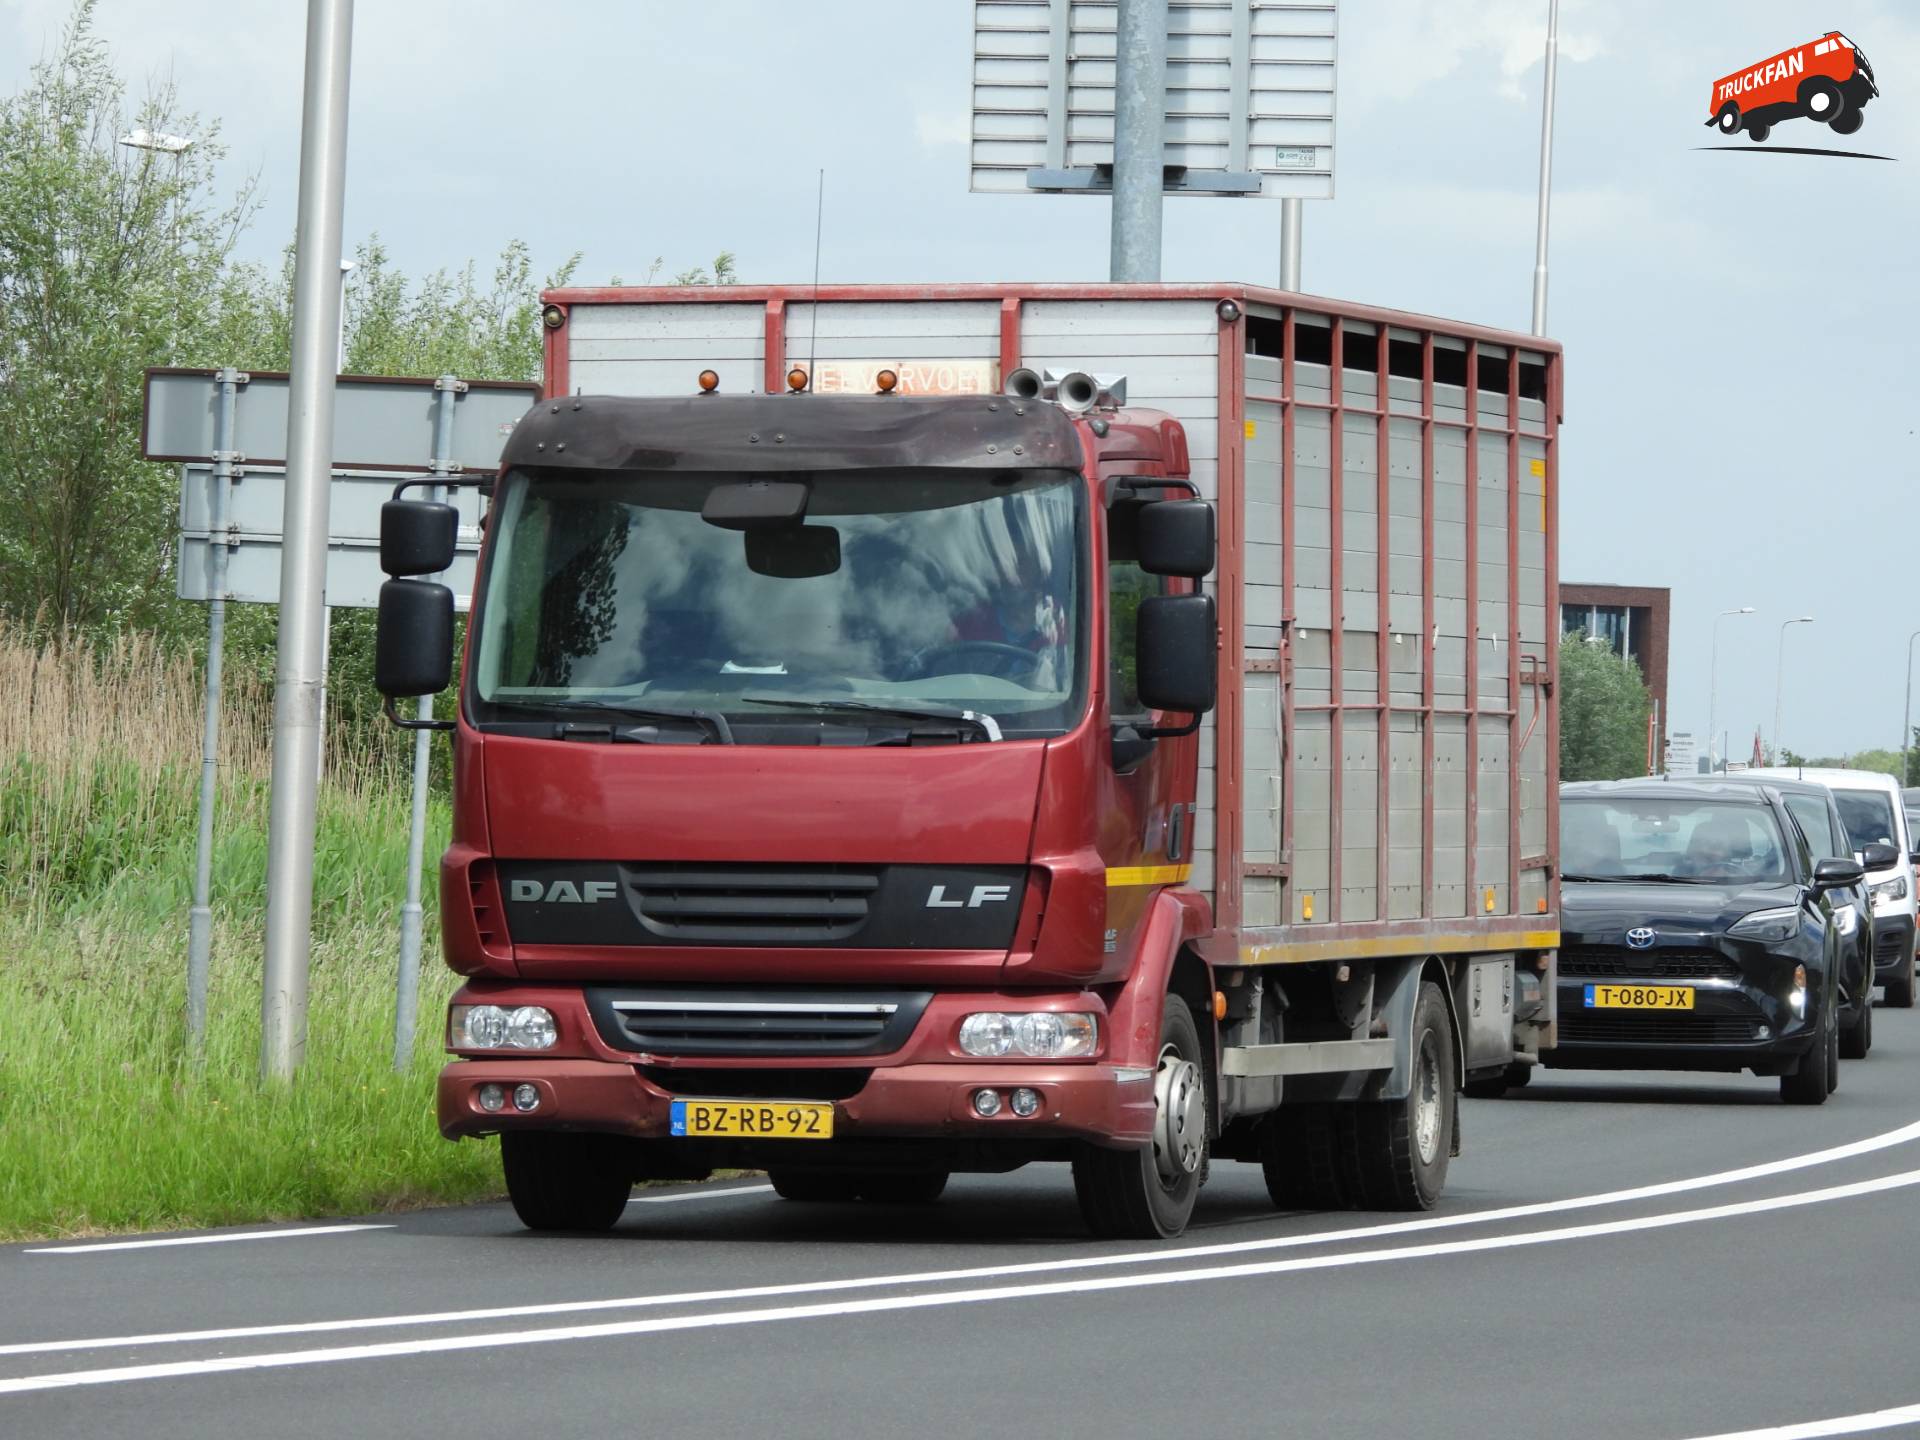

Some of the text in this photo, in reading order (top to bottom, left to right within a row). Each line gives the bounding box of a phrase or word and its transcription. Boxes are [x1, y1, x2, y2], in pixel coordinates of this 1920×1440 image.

[511, 879, 617, 903] DAF
[926, 885, 1012, 908] LF
[1601, 988, 1687, 1006] T-080-JX
[695, 1107, 820, 1133] BZ-RB-92
